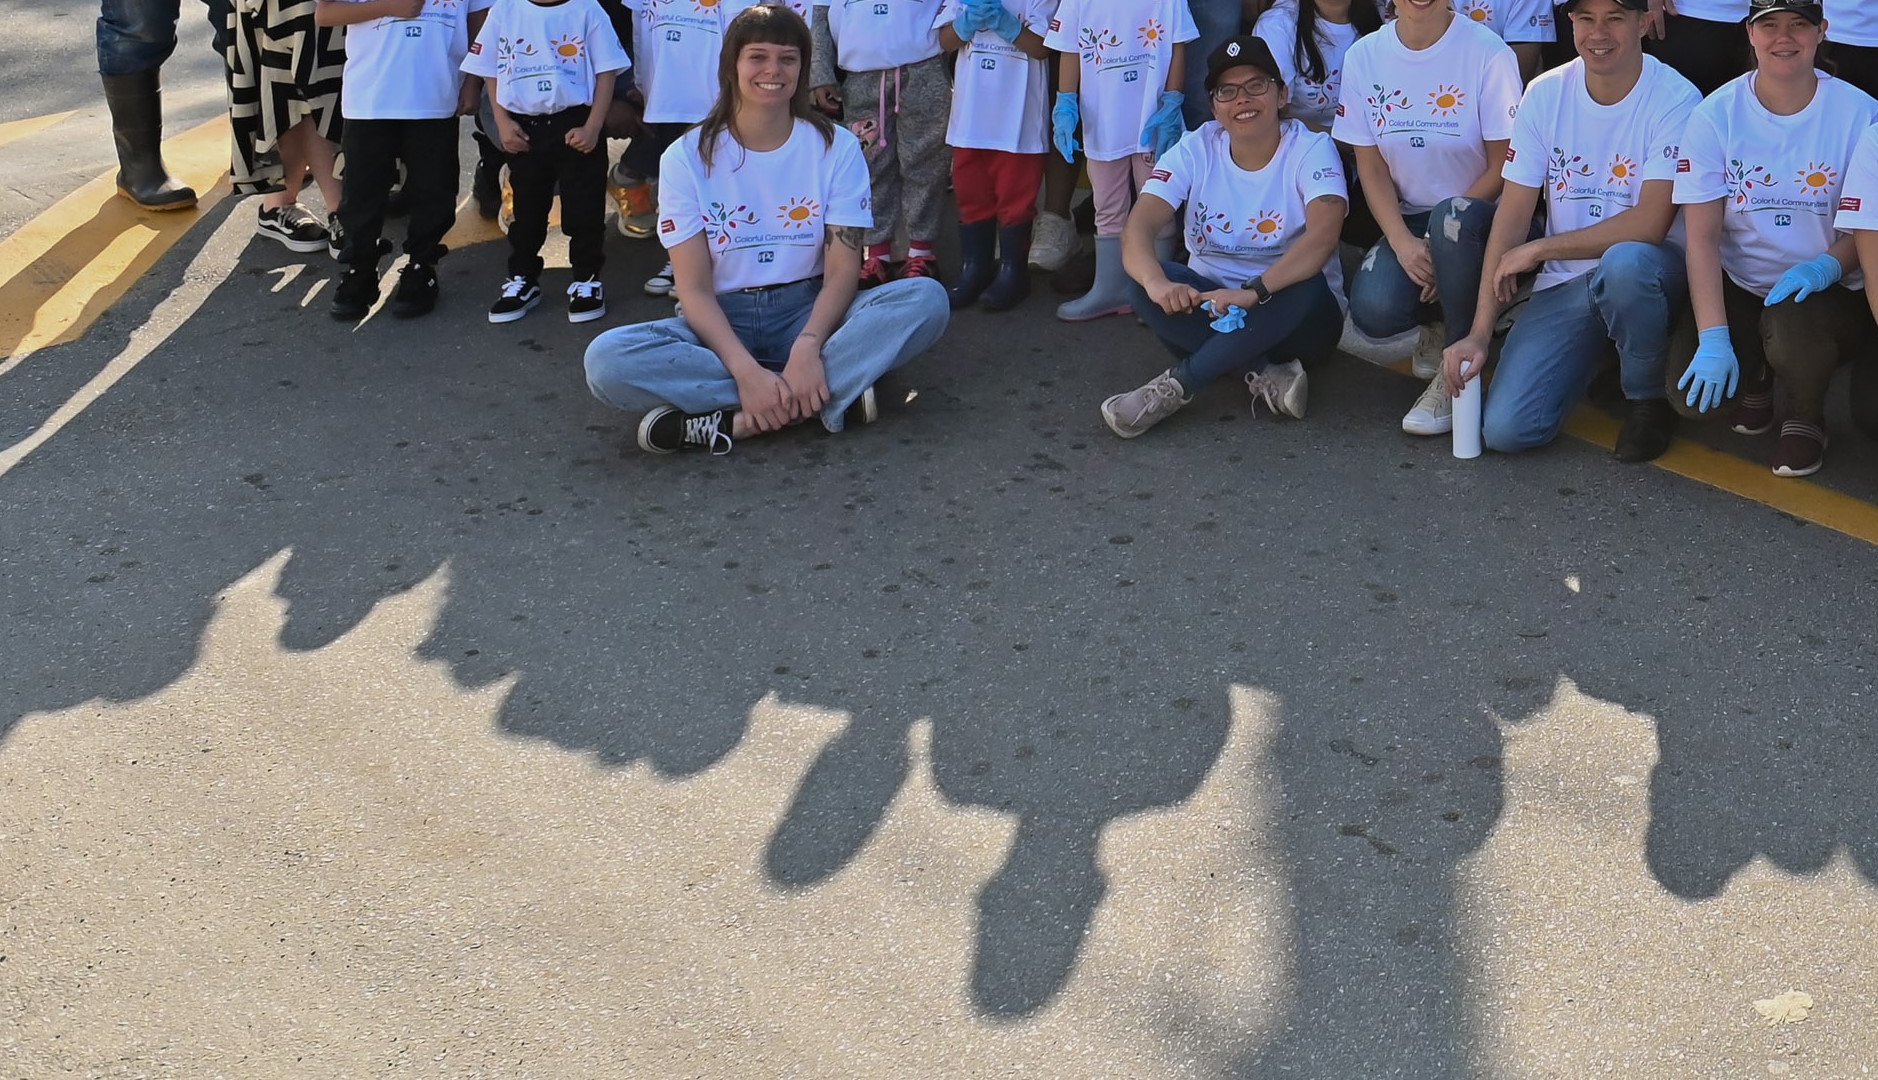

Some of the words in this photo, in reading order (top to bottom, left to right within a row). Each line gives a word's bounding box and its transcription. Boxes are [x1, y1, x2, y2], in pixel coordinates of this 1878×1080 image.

[1103, 56, 1126, 64] Colorful
[1389, 120, 1414, 128] Colorful
[1569, 186, 1596, 194] Colorful
[1750, 197, 1779, 205] Colorful
[1782, 199, 1828, 208] Communities
[1775, 215, 1791, 226] PPG
[735, 235, 762, 243] Colorful
[764, 233, 814, 242] Communities
